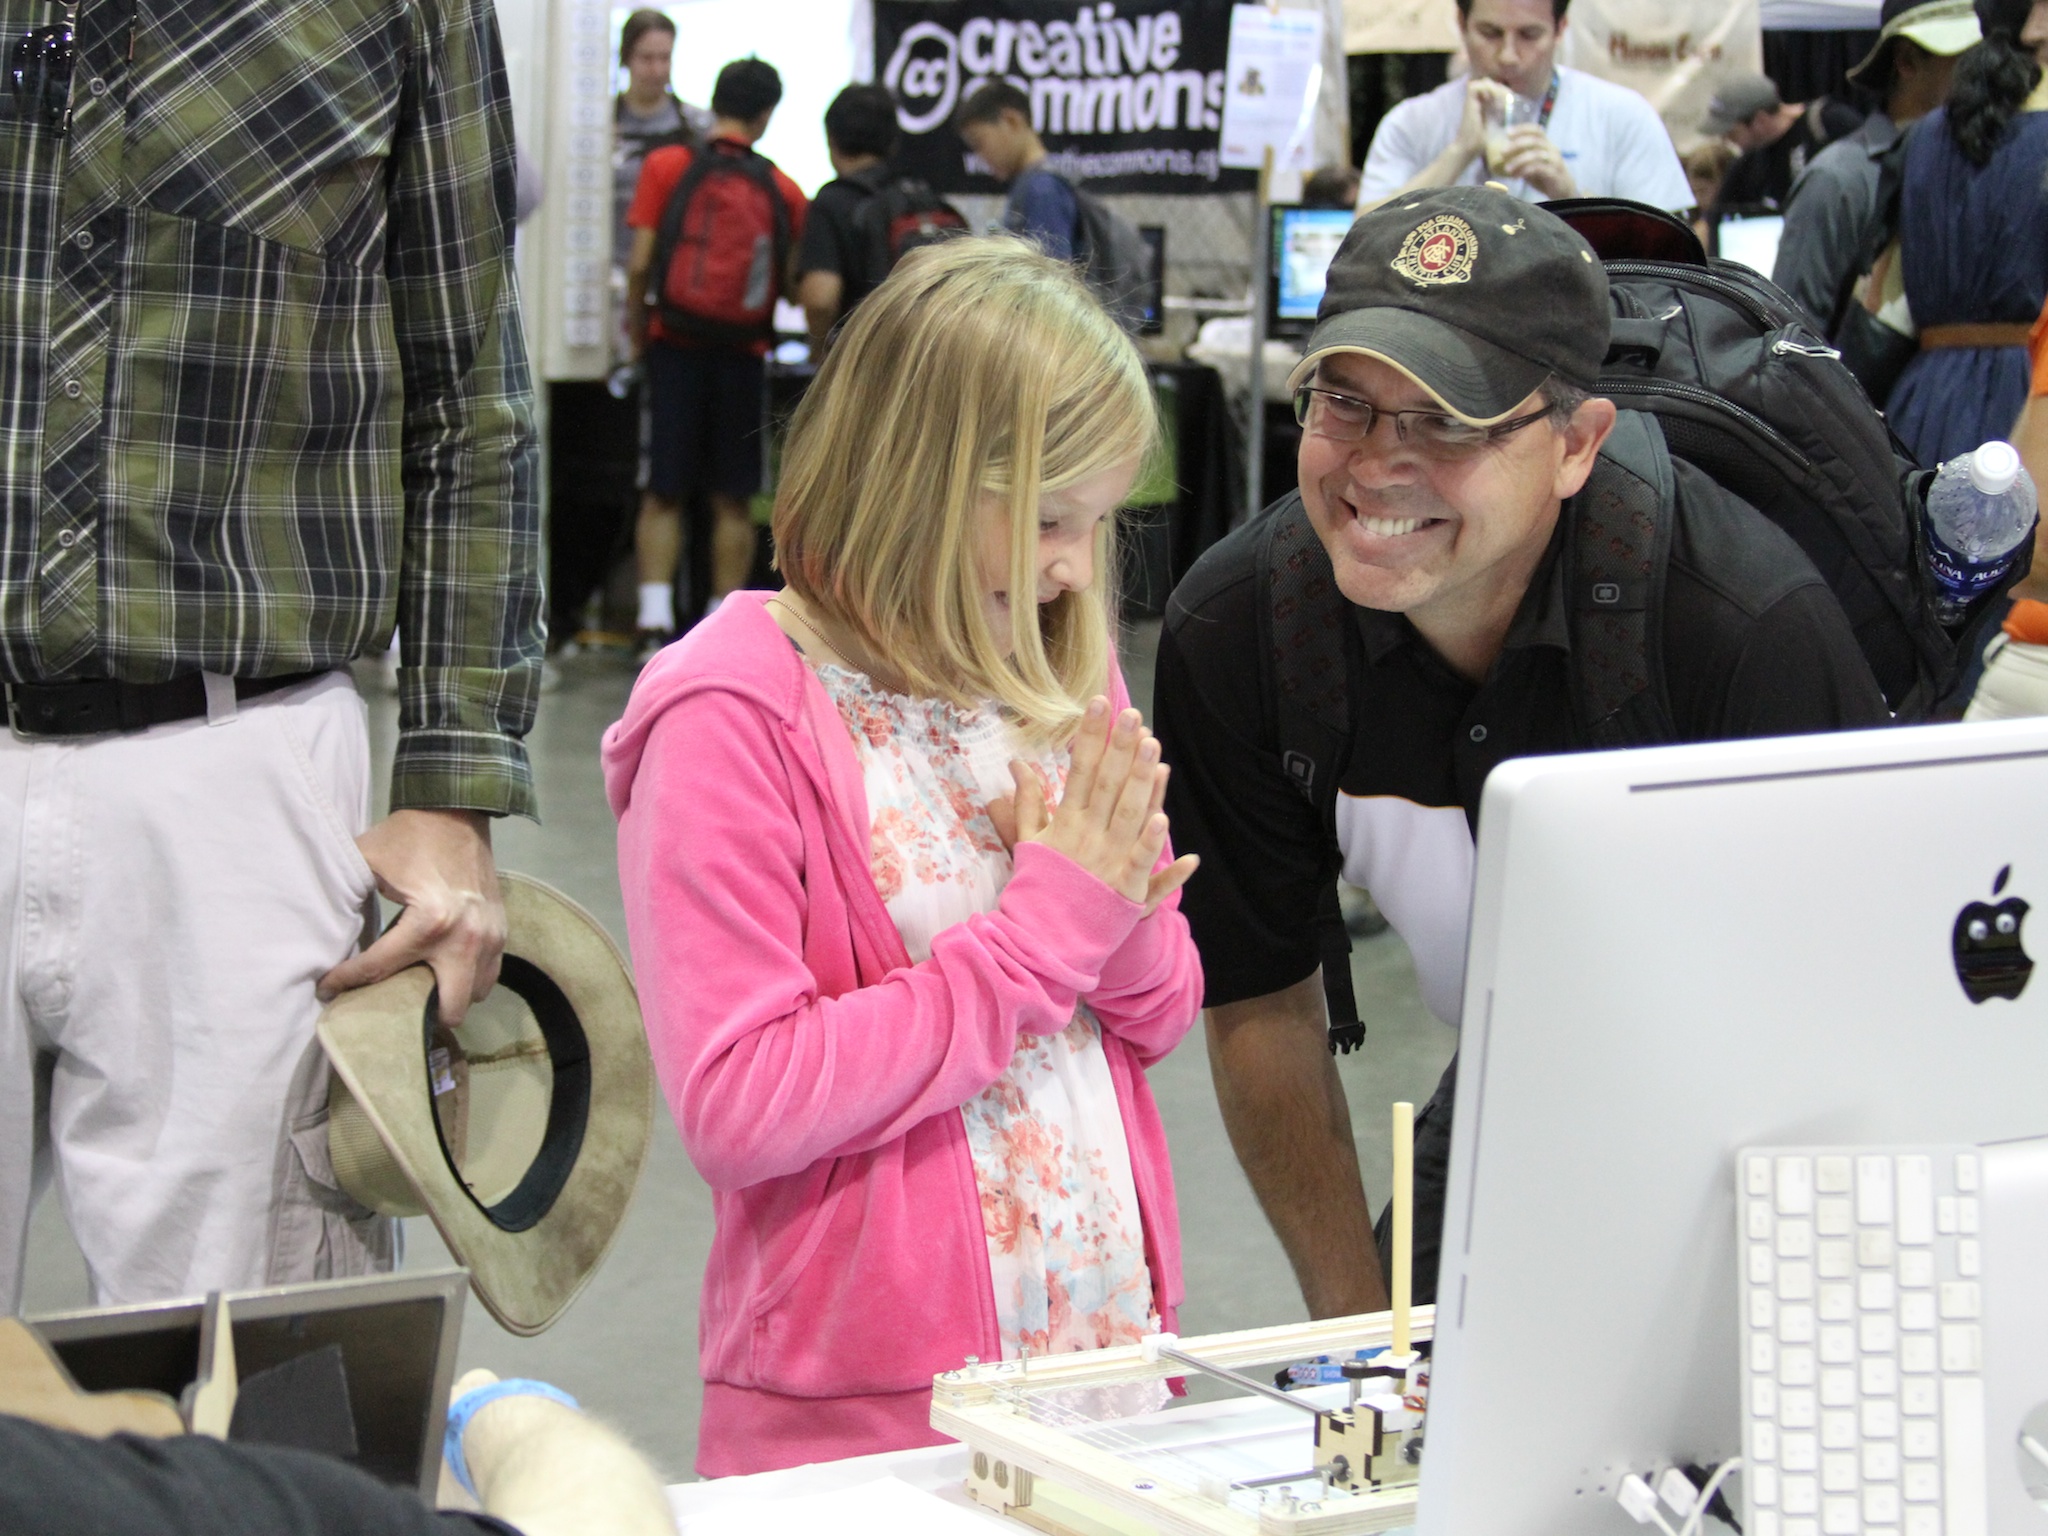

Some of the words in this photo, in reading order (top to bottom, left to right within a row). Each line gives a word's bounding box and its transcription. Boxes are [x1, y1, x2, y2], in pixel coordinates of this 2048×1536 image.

[958, 2, 1182, 77] creative
[902, 56, 947, 98] cc
[1423, 225, 1466, 247] ATLANTA
[1443, 254, 1464, 276] CLUB
